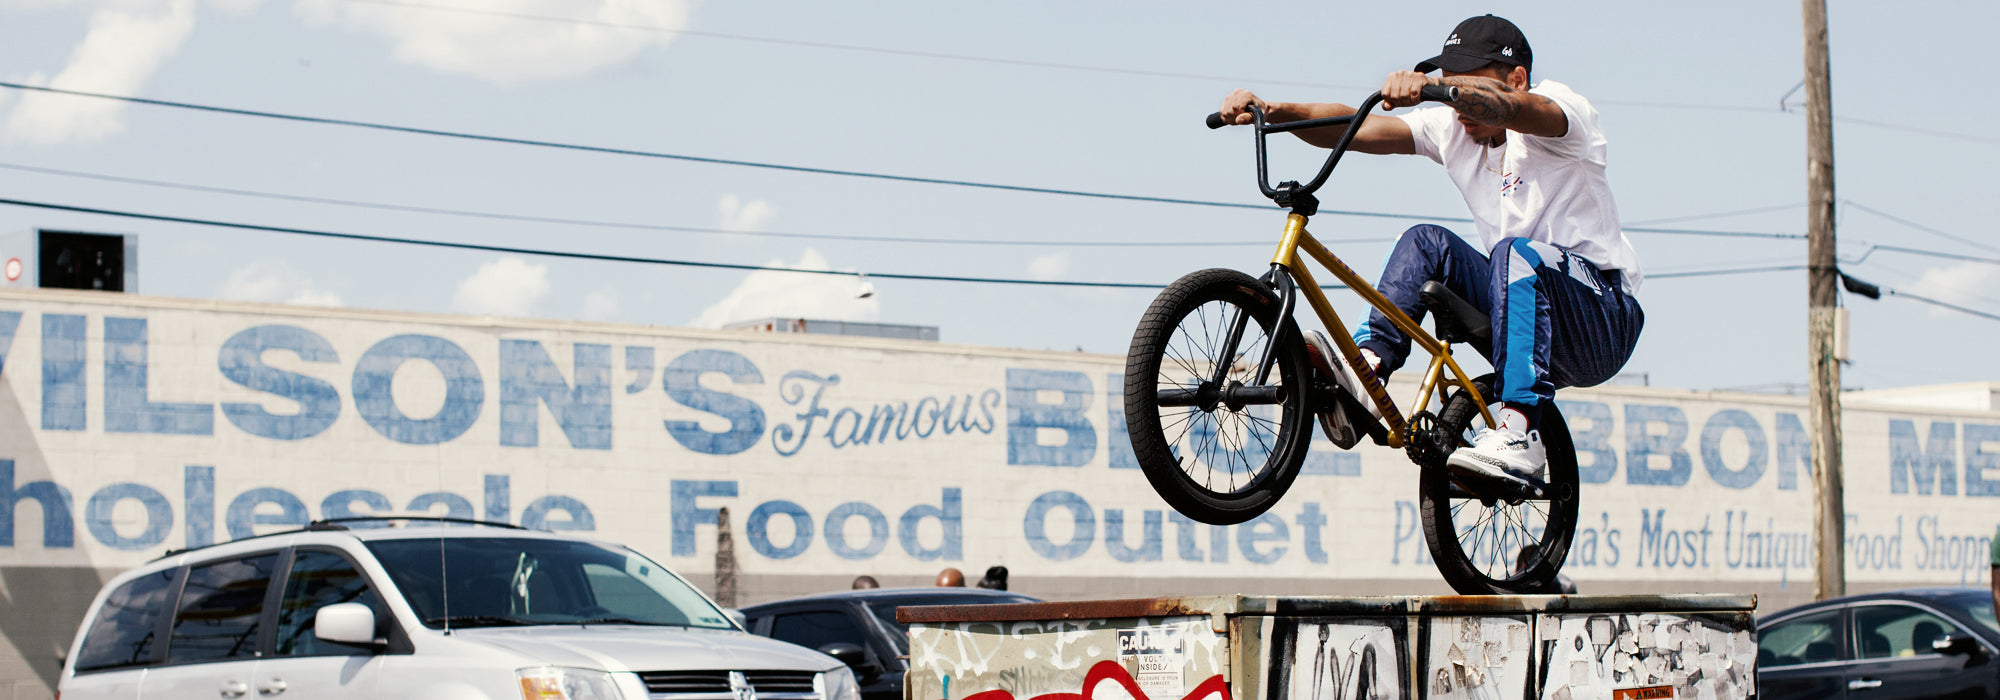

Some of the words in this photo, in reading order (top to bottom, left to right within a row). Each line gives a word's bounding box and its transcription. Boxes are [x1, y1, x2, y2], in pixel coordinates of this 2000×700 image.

[0, 311, 766, 455] ILSON'S
[772, 369, 1001, 457] Famous
[1432, 391, 1814, 490] BBON
[670, 479, 964, 562] Food
[1022, 490, 1328, 564] Outlet
[1636, 508, 1712, 568] Most
[1725, 510, 1815, 591] Uniqu
[1643, 688, 1670, 699] WARNING
